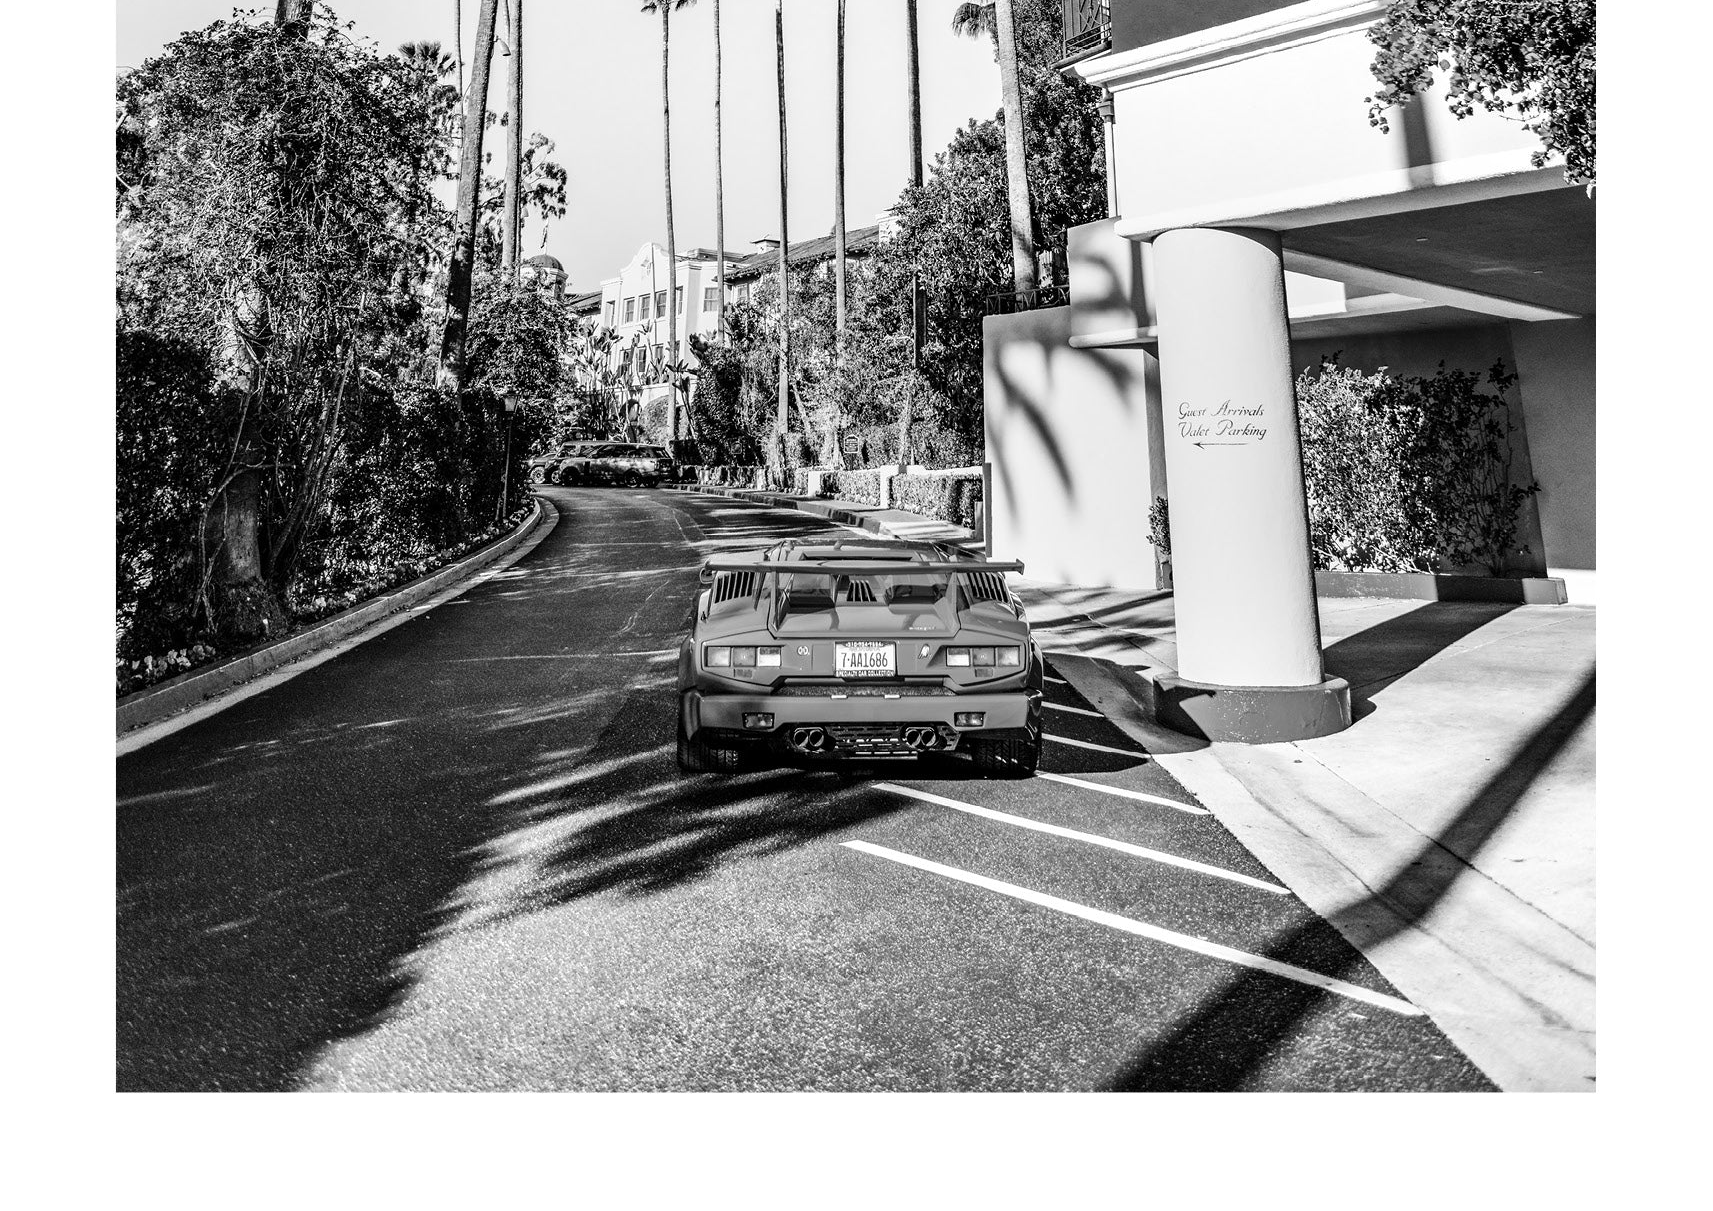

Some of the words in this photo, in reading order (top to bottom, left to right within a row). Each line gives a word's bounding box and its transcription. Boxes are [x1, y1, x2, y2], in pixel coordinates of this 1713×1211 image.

[1178, 401, 1207, 420] Guest
[1211, 399, 1265, 417] Arrivals
[1178, 421, 1210, 438] Valet
[1216, 419, 1267, 441] Parking
